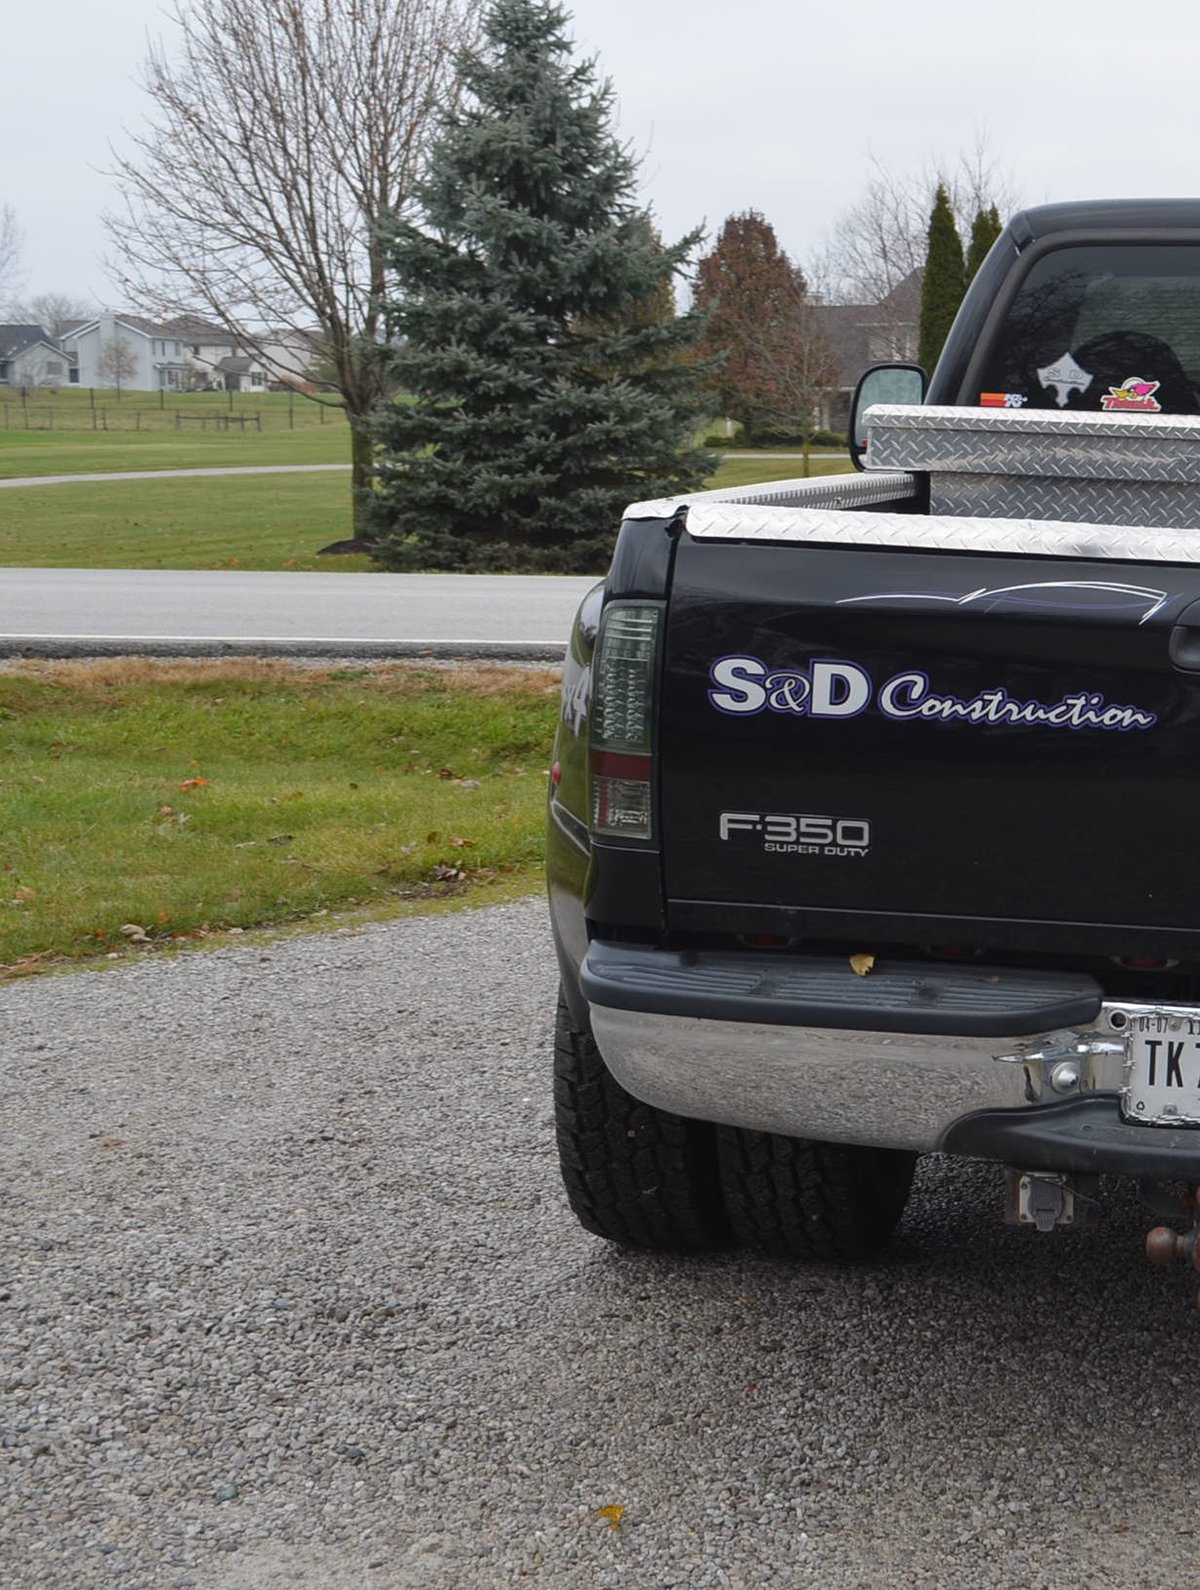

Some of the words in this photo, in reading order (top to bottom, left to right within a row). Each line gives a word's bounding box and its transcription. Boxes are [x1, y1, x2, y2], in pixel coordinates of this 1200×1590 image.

[711, 656, 869, 718] S&D
[879, 673, 1157, 731] Construction
[764, 843, 820, 855] SUPER
[823, 846, 870, 858] DUTY
